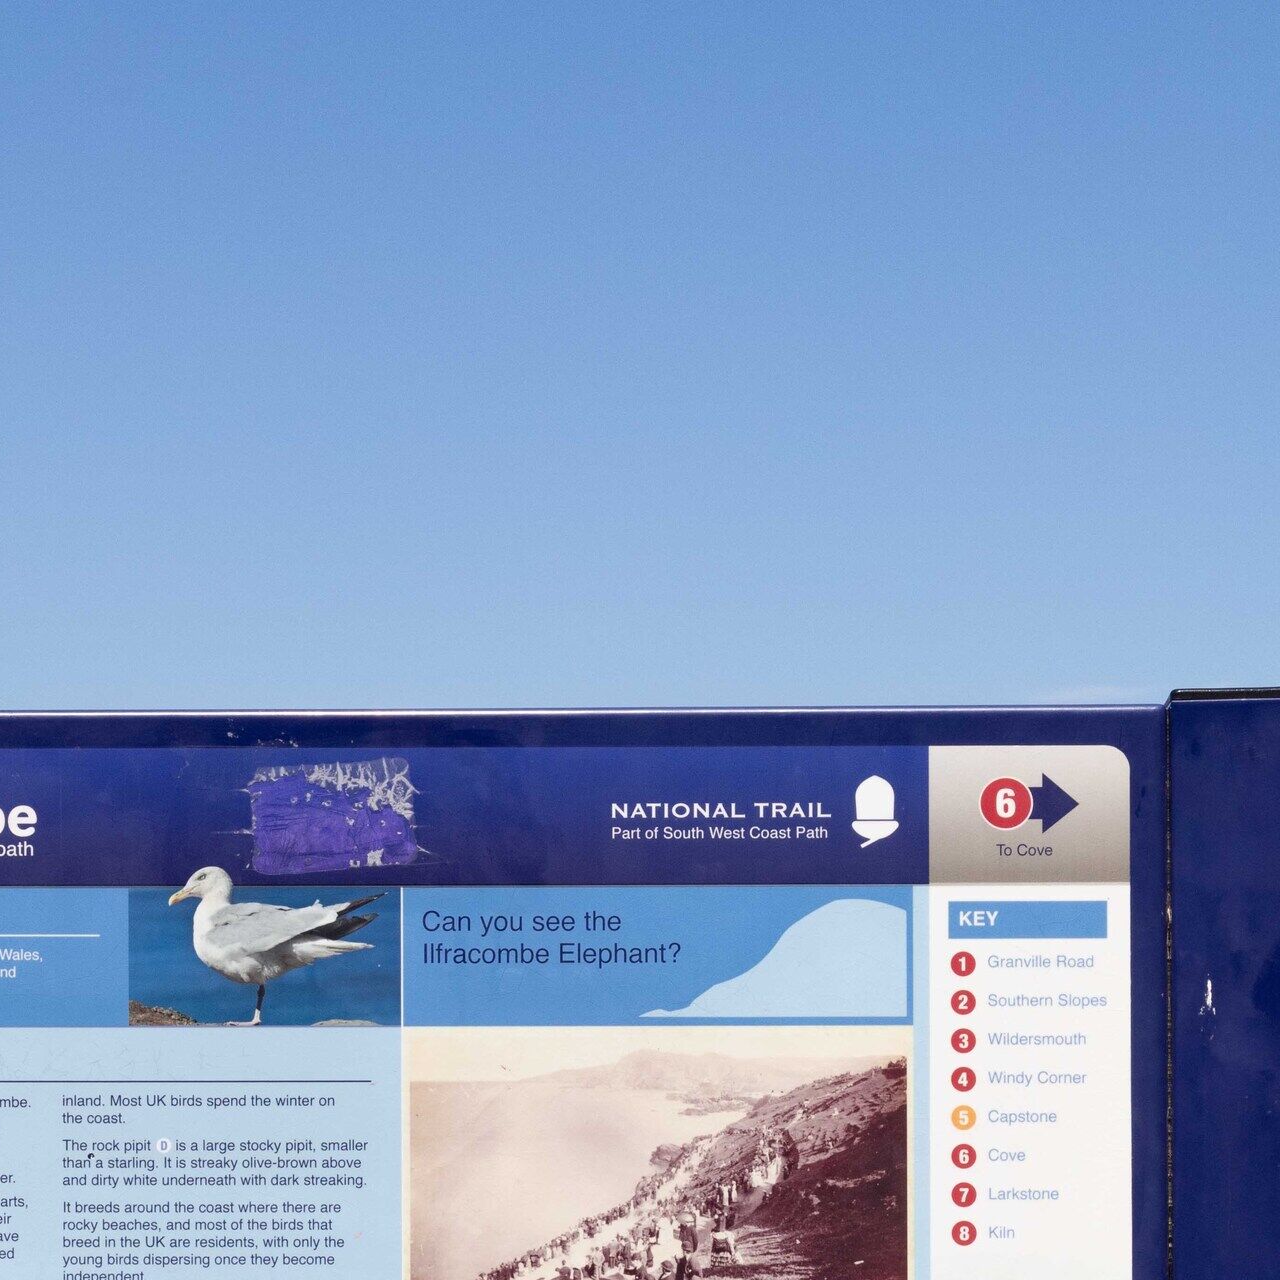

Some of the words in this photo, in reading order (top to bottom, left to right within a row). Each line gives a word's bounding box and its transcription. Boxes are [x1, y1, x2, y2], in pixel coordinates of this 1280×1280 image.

[995, 788, 1016, 817] 6
[611, 802, 746, 819] NATIONAL
[753, 802, 832, 818] TRAIL
[611, 826, 641, 840] Part
[644, 826, 659, 840] of
[663, 826, 705, 840] South
[708, 826, 746, 840] West
[749, 825, 792, 839] Coast
[796, 825, 828, 839] Path
[995, 843, 1013, 857] To
[1016, 843, 1053, 857] Cove
[422, 910, 471, 932] Can
[479, 915, 523, 938] you
[532, 915, 576, 932] see
[583, 910, 622, 932] the
[959, 910, 999, 927] KEY
[423, 942, 550, 965] Ilfracombe
[559, 942, 681, 970] Elephant?
[987, 954, 1051, 969] Granville
[1056, 954, 1094, 968] Road
[958, 957, 970, 972] 1
[958, 996, 970, 1011] 2
[987, 993, 1053, 1007] Southern
[1058, 993, 1108, 1009] Slopes
[958, 1034, 970, 1049] 3
[987, 1032, 1087, 1046] Wildersmouth
[958, 1073, 970, 1088] 4
[987, 1071, 1033, 1088] Windy
[1037, 1070, 1087, 1084] Corner
[958, 1111, 970, 1126] 5
[987, 1109, 1058, 1126] Capstone
[958, 1150, 970, 1165] 6
[987, 1148, 1026, 1162] Cove
[958, 1189, 970, 1204] 7
[988, 1187, 1060, 1201] Larkstone
[958, 1227, 970, 1242] 8
[988, 1225, 1015, 1239] Kiln
